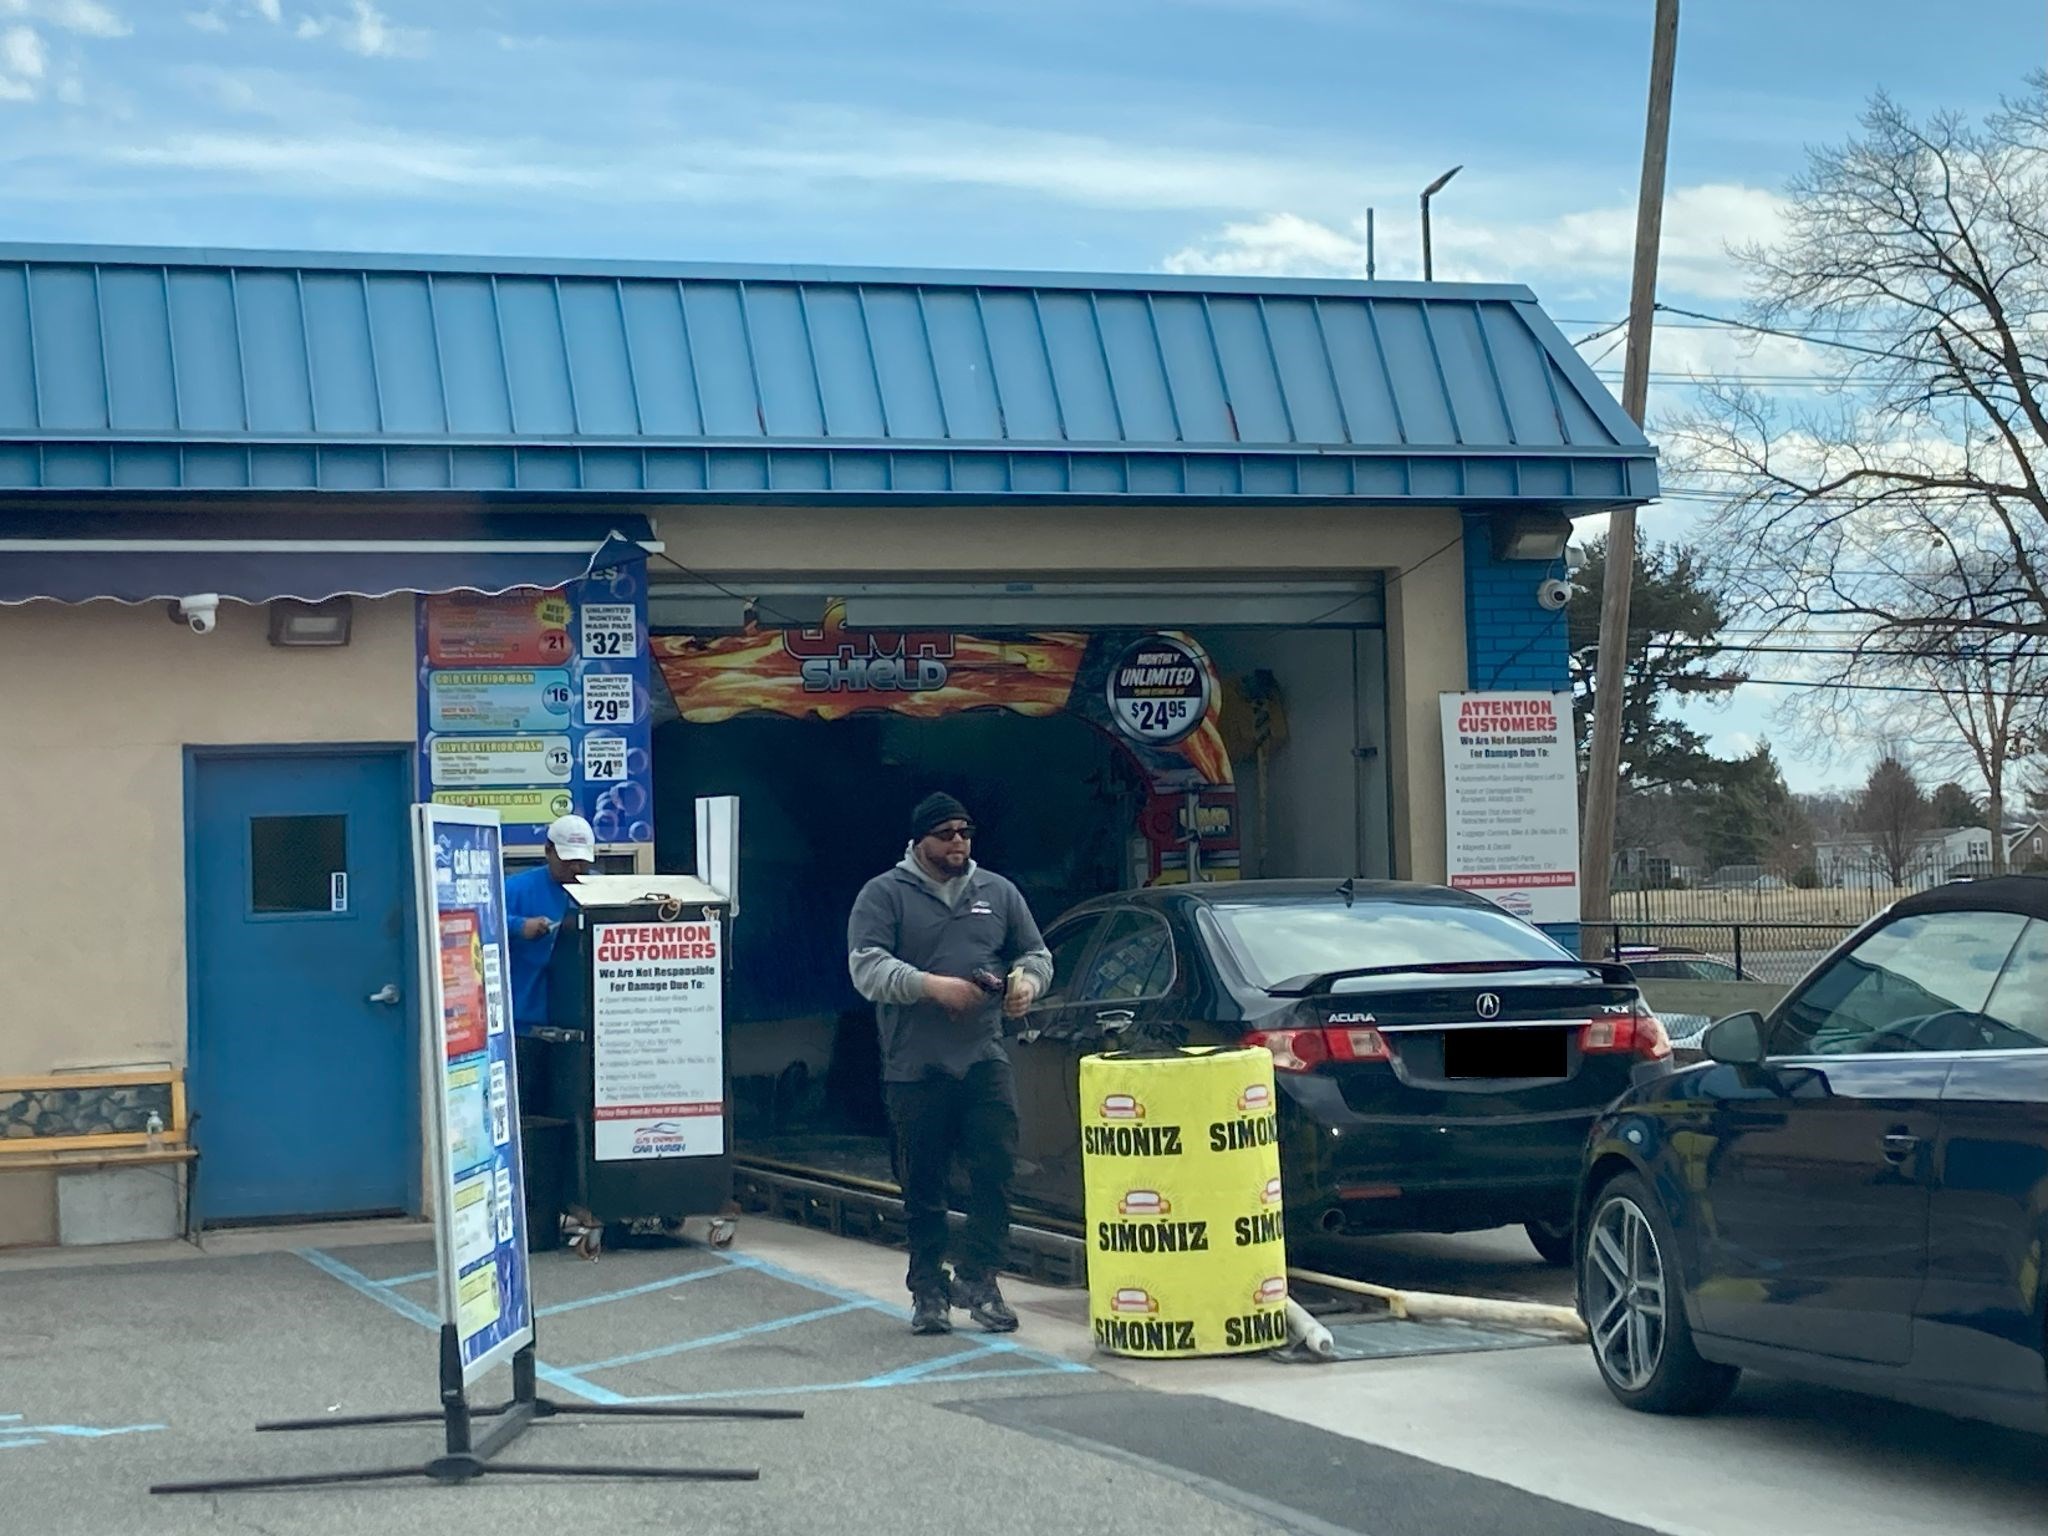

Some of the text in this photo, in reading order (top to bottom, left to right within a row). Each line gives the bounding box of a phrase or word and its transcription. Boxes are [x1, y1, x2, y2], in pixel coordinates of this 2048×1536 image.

[1137, 653, 1181, 665] MONTHLY
[507, 673, 536, 684] WASH
[801, 659, 948, 692] SHIELD
[1120, 666, 1196, 687] UNLIMITED
[1461, 701, 1552, 716] ATTENTION
[1458, 716, 1558, 732] CUSTOMERS
[515, 741, 544, 752] WASH
[1460, 735, 1558, 745] We Are Not Responsible
[1470, 750, 1483, 758] For
[1485, 749, 1519, 758] Damage
[1520, 748, 1536, 757] Due
[602, 926, 711, 944] ATTENTION
[597, 943, 717, 962] CUSTOMERS
[599, 966, 716, 978] We Are Not Responsible
[610, 982, 626, 992] For
[627, 981, 668, 992] Damage
[669, 981, 689, 990] Due
[1328, 1013, 1376, 1022] ACURA
[1085, 1125, 1183, 1156] SIMONIZ
[1099, 1220, 1209, 1252] SIMONIZ
[1095, 1310, 1288, 1350] SIMONIZ SIMO
